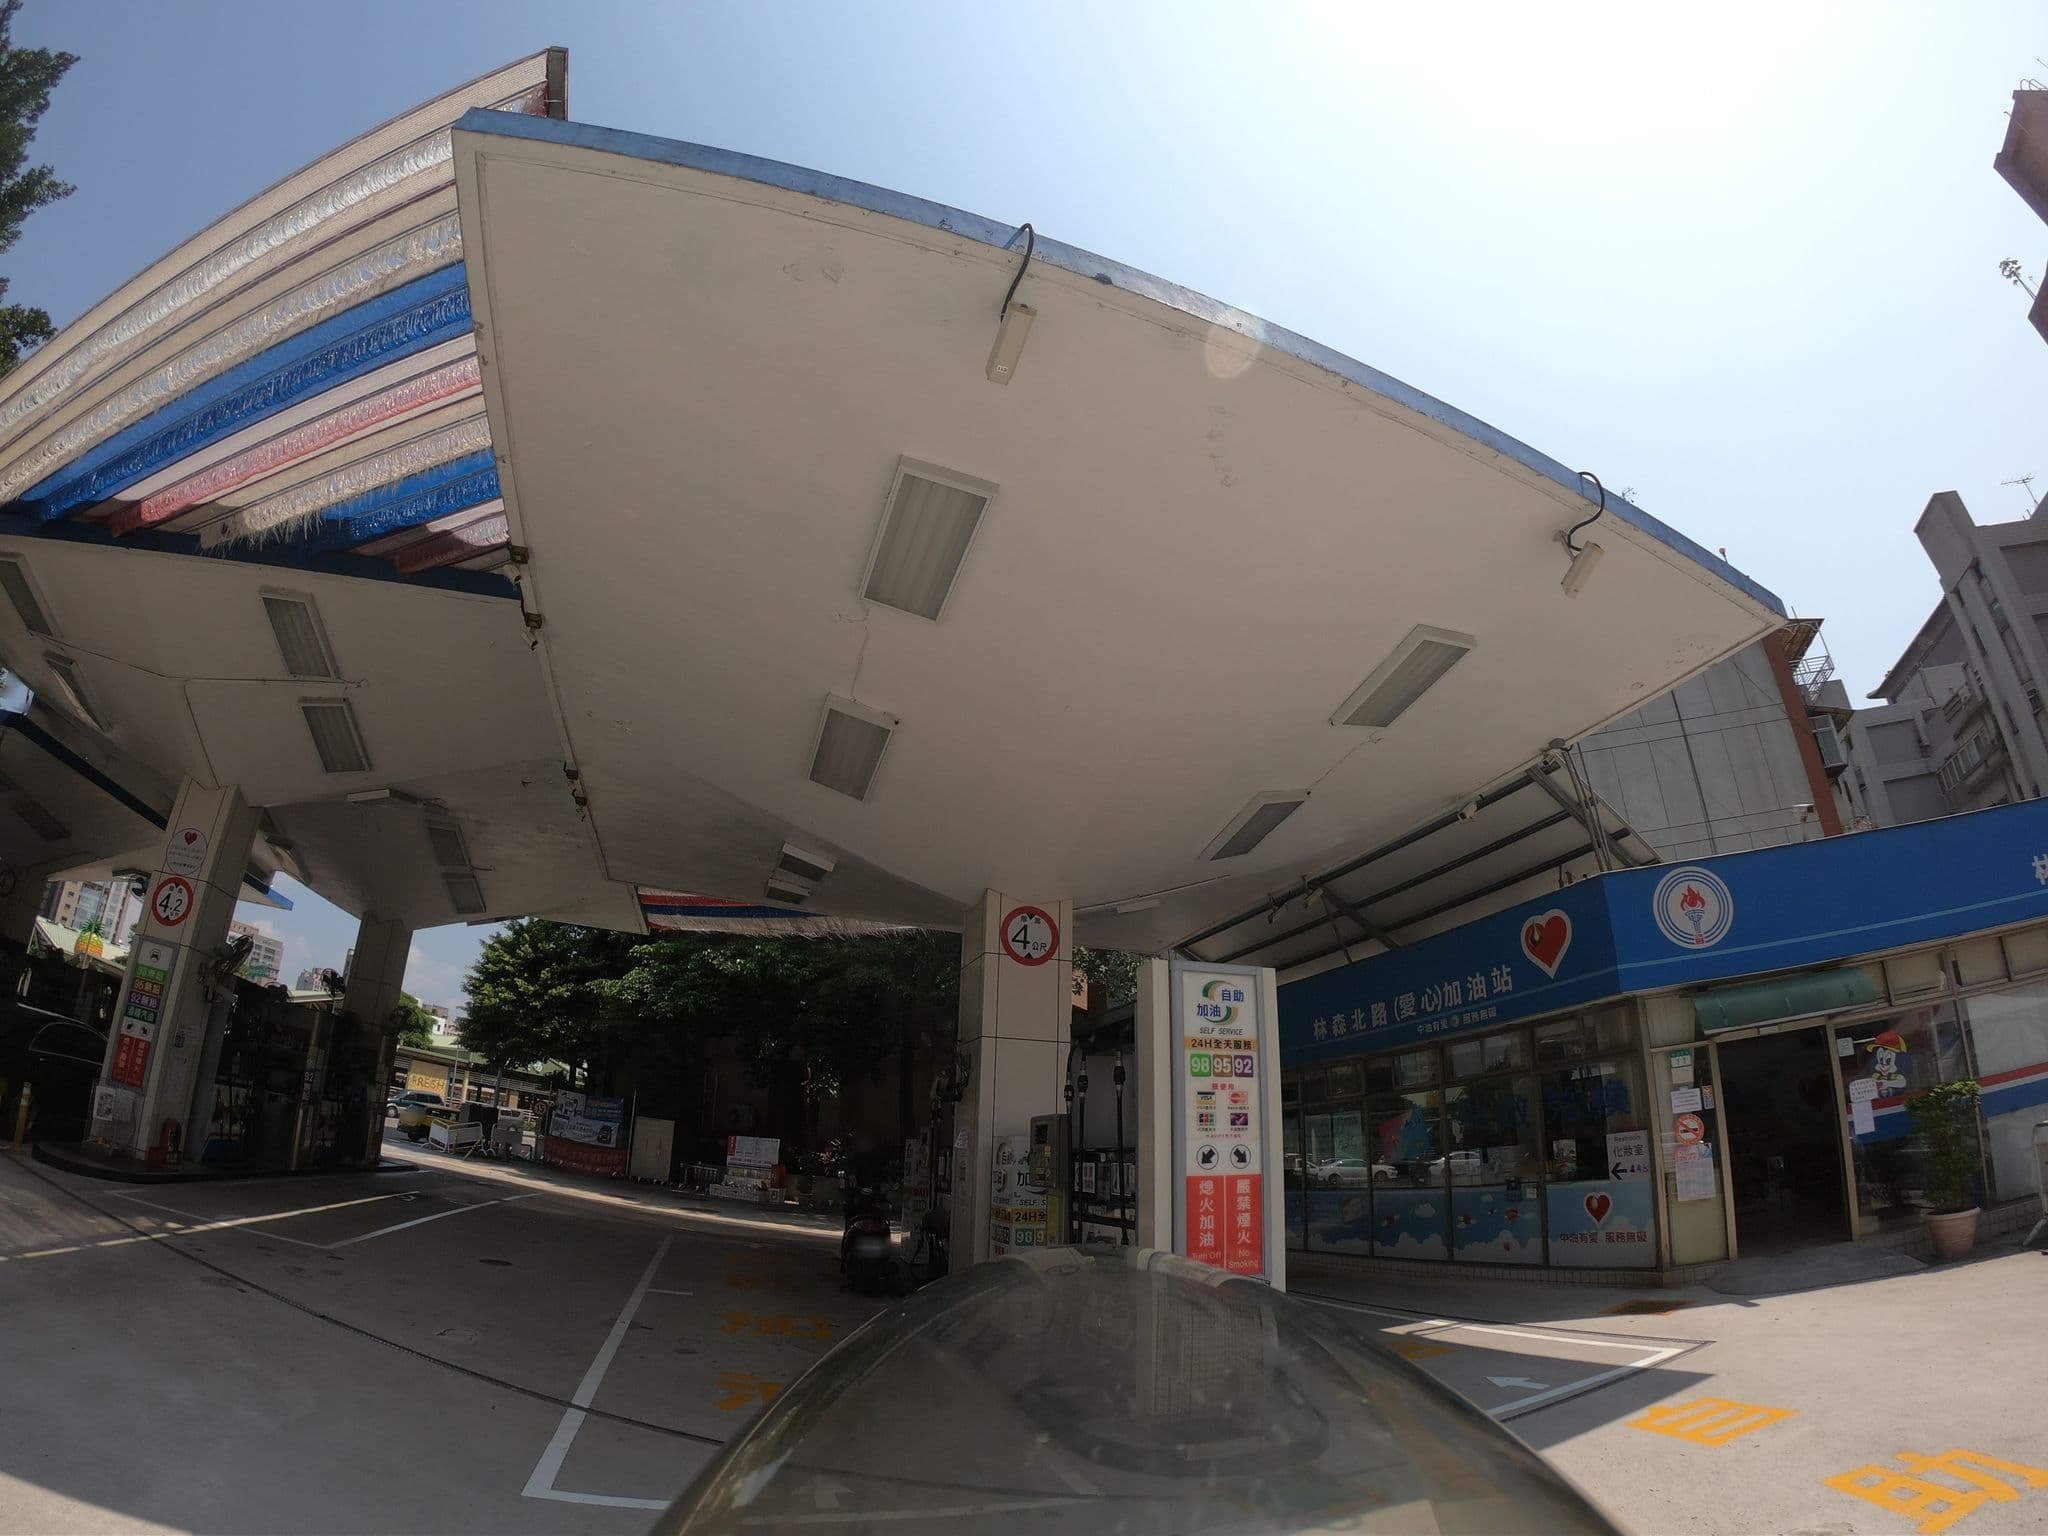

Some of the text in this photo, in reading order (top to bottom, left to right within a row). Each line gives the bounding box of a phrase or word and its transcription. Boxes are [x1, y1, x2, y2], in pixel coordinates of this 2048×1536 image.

[158, 892, 183, 913] 4.2
[1011, 924, 1030, 950] 4
[1221, 989, 1244, 1002] 自助
[1196, 1004, 1222, 1018] 加油
[1199, 1026, 1244, 1036] SELF SERVICE
[1191, 1039, 1252, 1050] 24H全天服務
[1191, 1057, 1253, 1074] 98 95 92
[1238, 1249, 1250, 1257] No
[1228, 1259, 1259, 1270] Smoking
